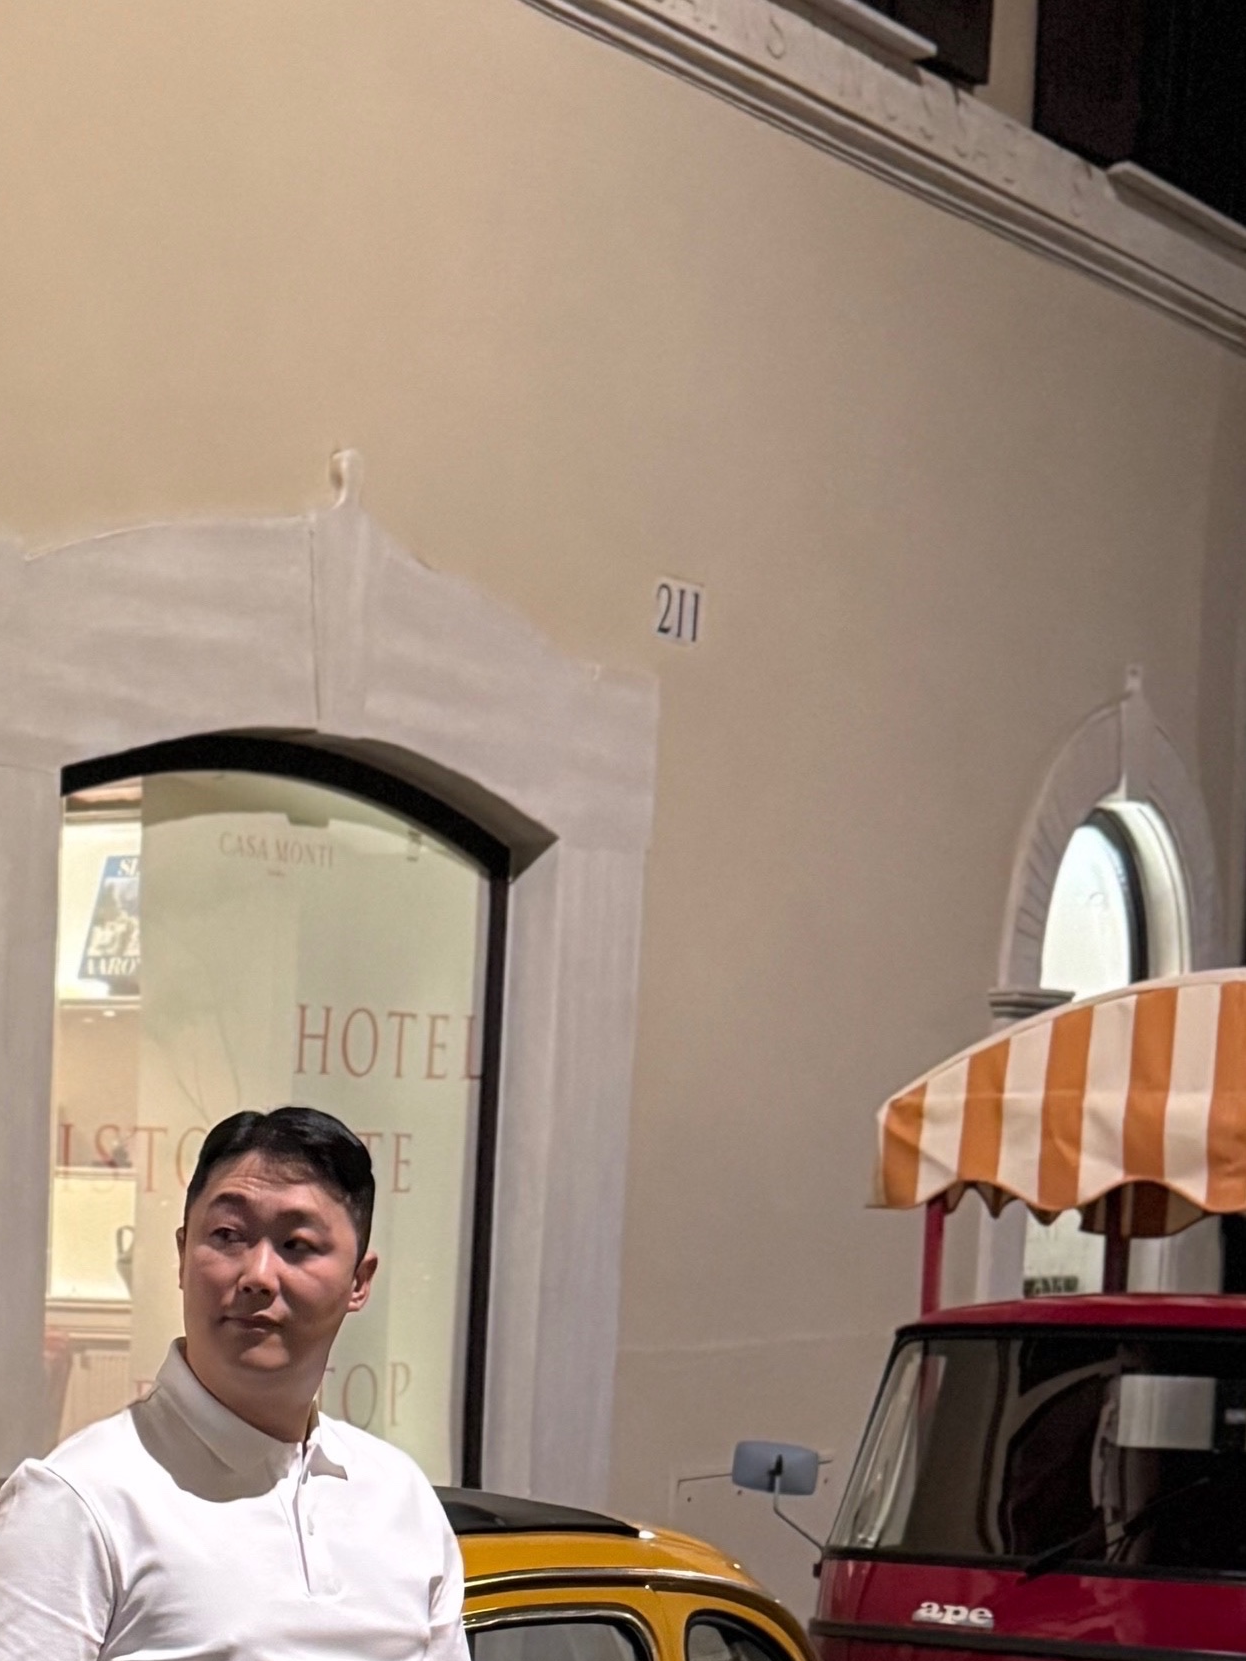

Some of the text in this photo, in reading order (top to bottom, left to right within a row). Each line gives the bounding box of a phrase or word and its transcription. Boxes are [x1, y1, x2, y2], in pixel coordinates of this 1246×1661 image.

[657, 583, 700, 642] 211
[219, 831, 268, 860] CASA
[293, 1003, 483, 1081] HOTEL
[919, 1601, 994, 1627] ape
